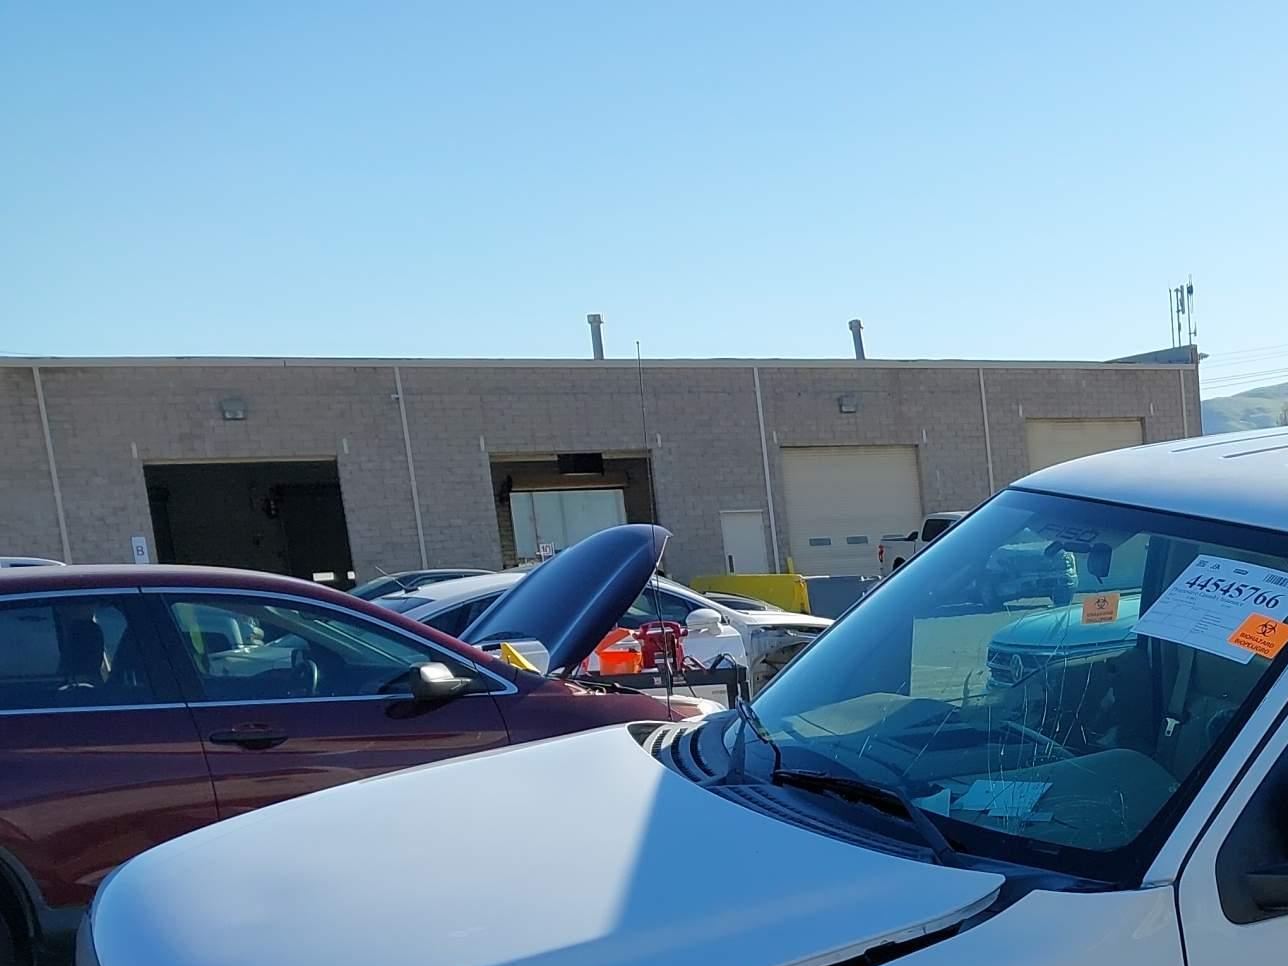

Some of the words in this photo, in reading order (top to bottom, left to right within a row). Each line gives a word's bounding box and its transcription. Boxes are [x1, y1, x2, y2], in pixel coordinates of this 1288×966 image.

[136, 545, 144, 556] B
[1185, 574, 1286, 609] 44545766
[1234, 638, 1270, 655] BIOPELIGRO
[1239, 632, 1275, 648] BIOHAZARD
